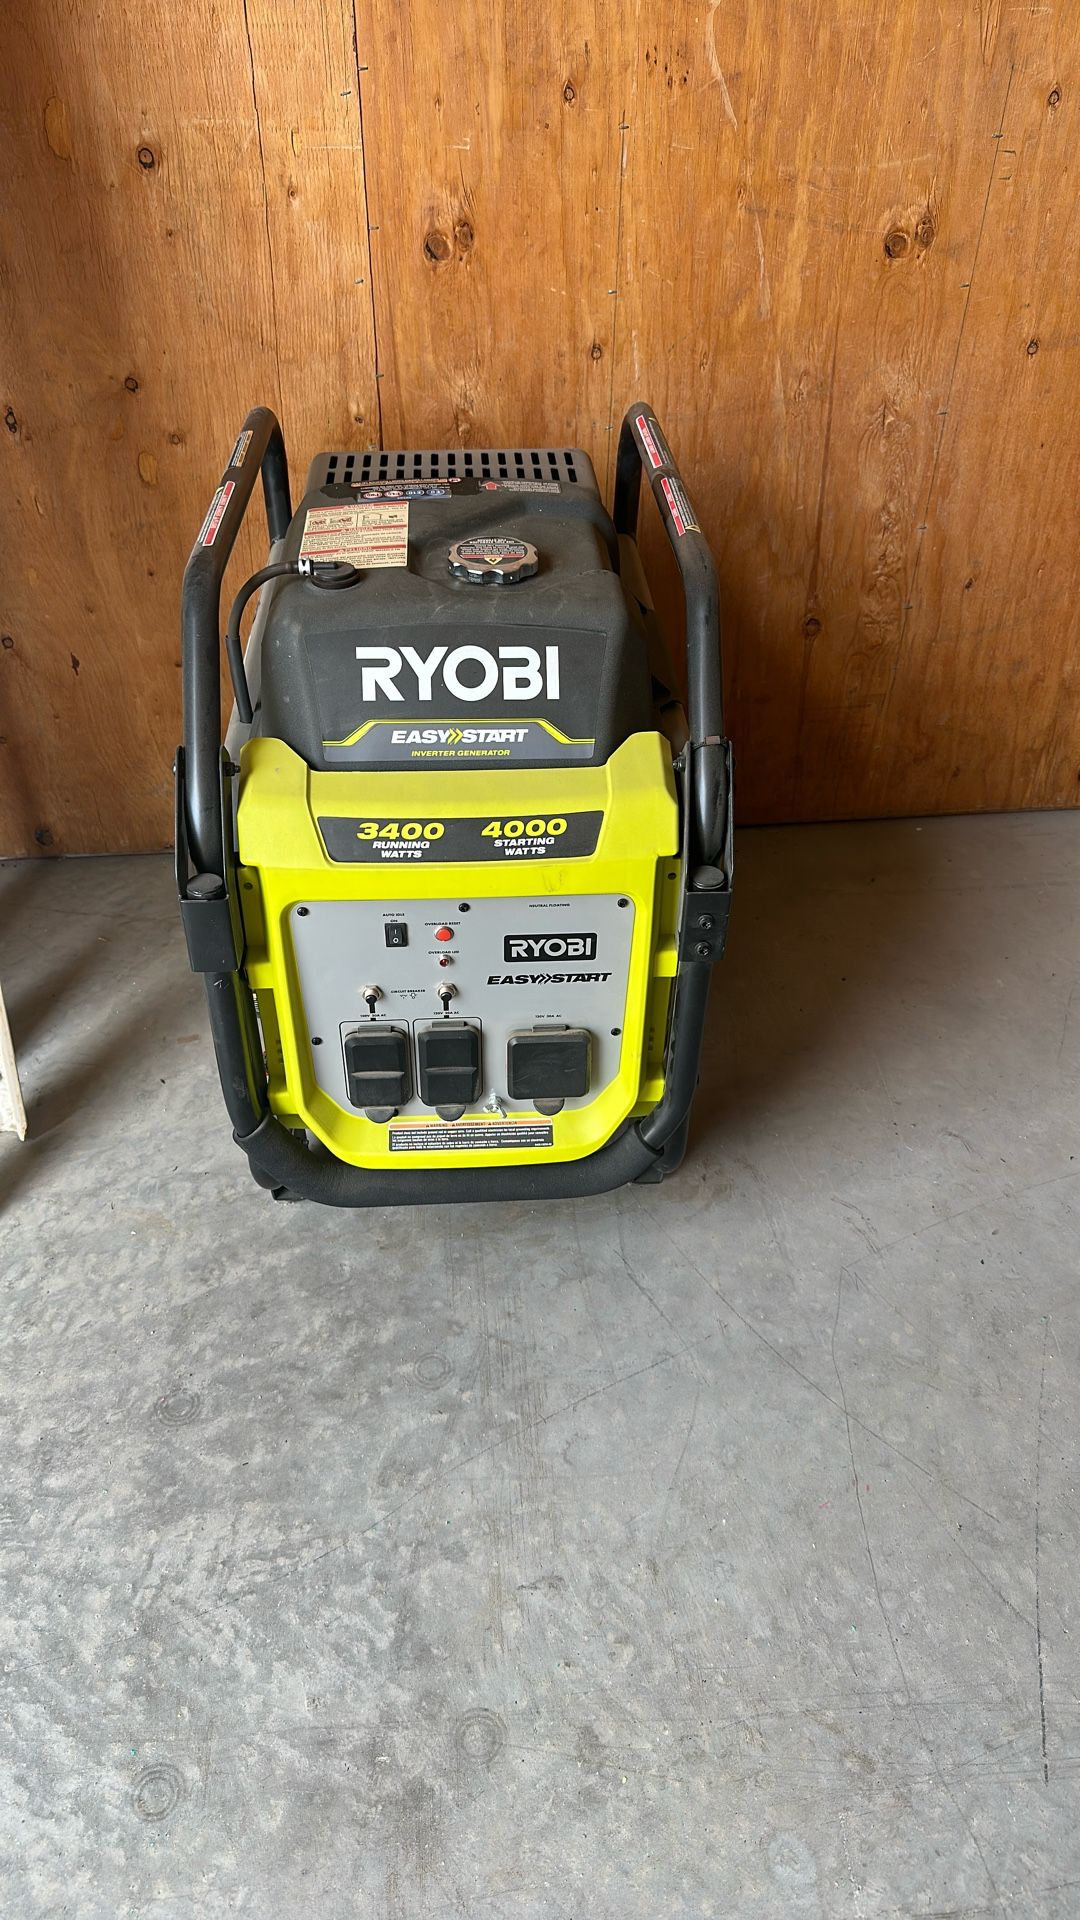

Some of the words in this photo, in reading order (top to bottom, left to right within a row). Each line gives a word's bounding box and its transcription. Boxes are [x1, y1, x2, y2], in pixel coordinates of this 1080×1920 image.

[355, 645, 560, 702] RYOBI
[391, 730, 450, 744] EASY
[462, 728, 528, 743] START
[356, 822, 445, 840] 3400
[480, 818, 568, 838] 4000
[372, 841, 430, 849] RUNNING
[494, 837, 555, 847] STARTING
[380, 850, 422, 858] WATTS
[504, 847, 546, 856] WATTS
[509, 938, 592, 958] RYOBI
[487, 974, 540, 985] EASY
[550, 973, 612, 983] START
